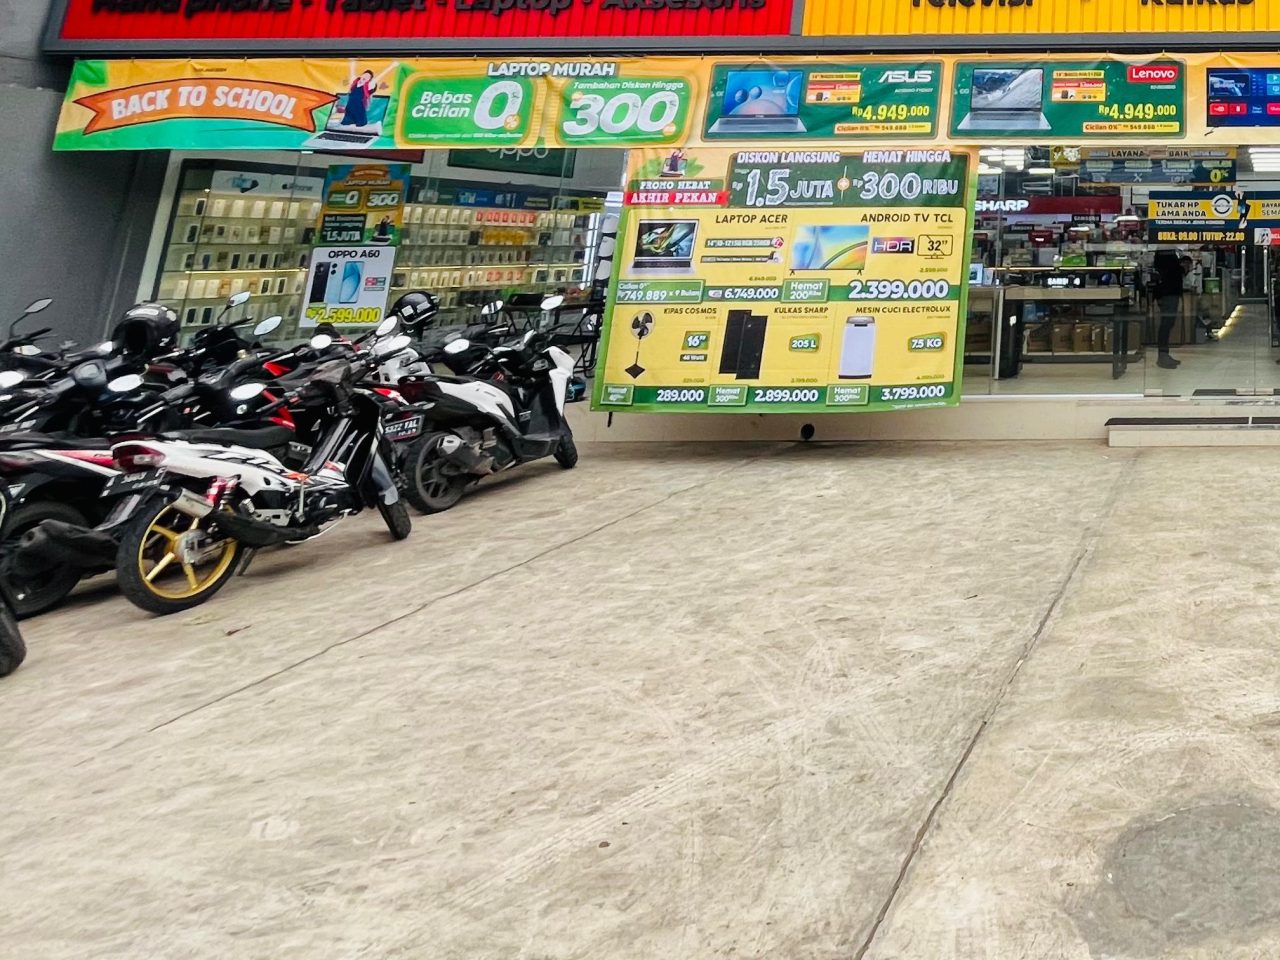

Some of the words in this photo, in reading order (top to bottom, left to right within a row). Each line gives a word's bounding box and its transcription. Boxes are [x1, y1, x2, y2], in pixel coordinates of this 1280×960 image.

[487, 62, 550, 77] LAPTOP
[552, 62, 615, 77] MURAH
[1132, 68, 1175, 79] Lenovo
[879, 70, 932, 83] ASUS
[573, 81, 620, 90] Tambahan
[621, 81, 650, 90] Diskon
[652, 80, 684, 91] Hingga
[111, 88, 172, 120] BACK
[178, 86, 207, 107] TO
[213, 85, 297, 119] SCHOOL
[420, 91, 473, 105] Bebas
[411, 105, 471, 119] Cicilan
[562, 91, 680, 135] 300
[737, 152, 779, 163] DISKON
[780, 152, 840, 163] LANGSUNG
[863, 151, 901, 163] HEMAT
[905, 151, 951, 162] HINGGA
[640, 181, 673, 190] PROMO
[678, 181, 711, 189] HEBAT
[745, 168, 791, 206] 1.5
[790, 180, 834, 198] JUTA
[860, 171, 922, 199] 300
[922, 178, 958, 195] RIBU
[367, 193, 399, 206] 300
[631, 192, 669, 204] AKHIR
[674, 192, 717, 203] PEKAN
[974, 200, 1030, 211] SHARP
[715, 214, 757, 224] LAPTOP
[760, 214, 788, 223] ACER
[861, 213, 911, 223] ANDROID
[914, 213, 930, 223] TV
[934, 213, 953, 223] TCL
[873, 240, 913, 252] HDR
[328, 250, 358, 259] OPPO
[360, 250, 380, 259] A60
[791, 282, 824, 290] Hemat
[848, 279, 950, 299] 2.399.000
[724, 288, 779, 299] 6.749.000
[790, 290, 809, 299] 200
[315, 307, 382, 324] 2.599.000
[663, 307, 683, 315] KIPAS
[685, 307, 717, 315] COSMOS
[856, 306, 880, 314] MESIN
[902, 305, 951, 313] ELECTROLUX
[656, 390, 704, 402] 289.000
[754, 389, 818, 402] 2.899.000
[881, 385, 945, 401] 3.799.000
